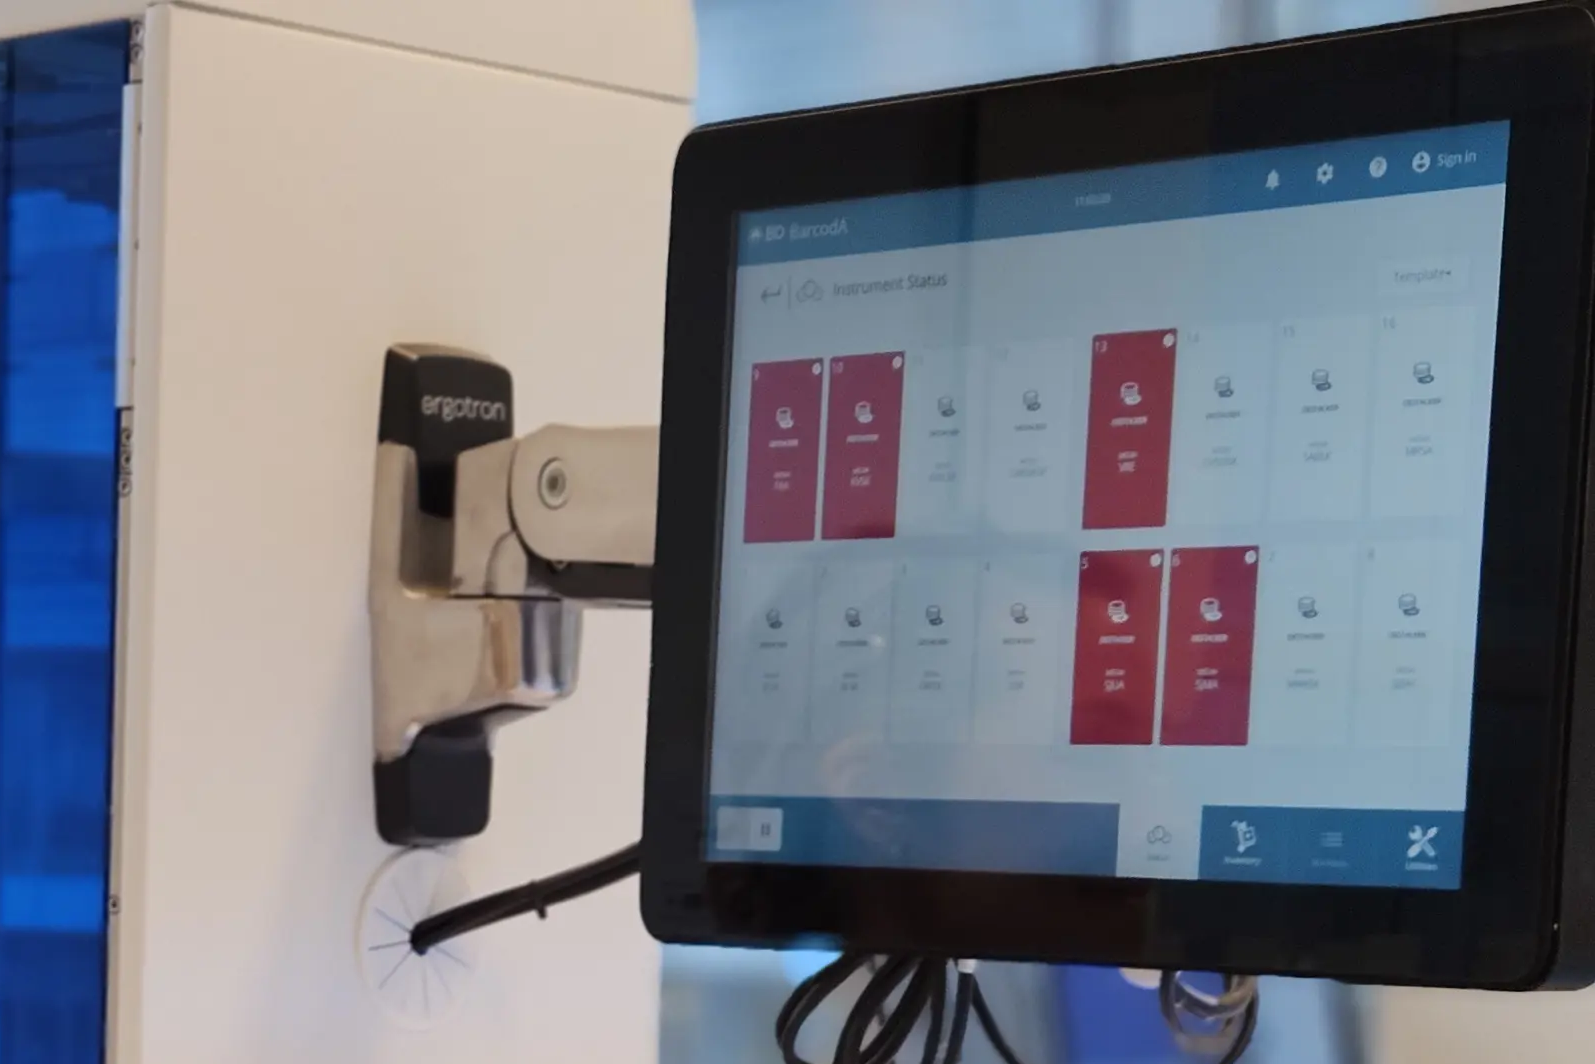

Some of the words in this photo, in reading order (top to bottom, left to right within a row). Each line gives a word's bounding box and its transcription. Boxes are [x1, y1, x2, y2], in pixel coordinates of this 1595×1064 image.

[1437, 152, 1462, 169] Sign
[832, 277, 904, 298] Instrument
[907, 272, 949, 291] Status
[420, 395, 507, 422] ergotron
